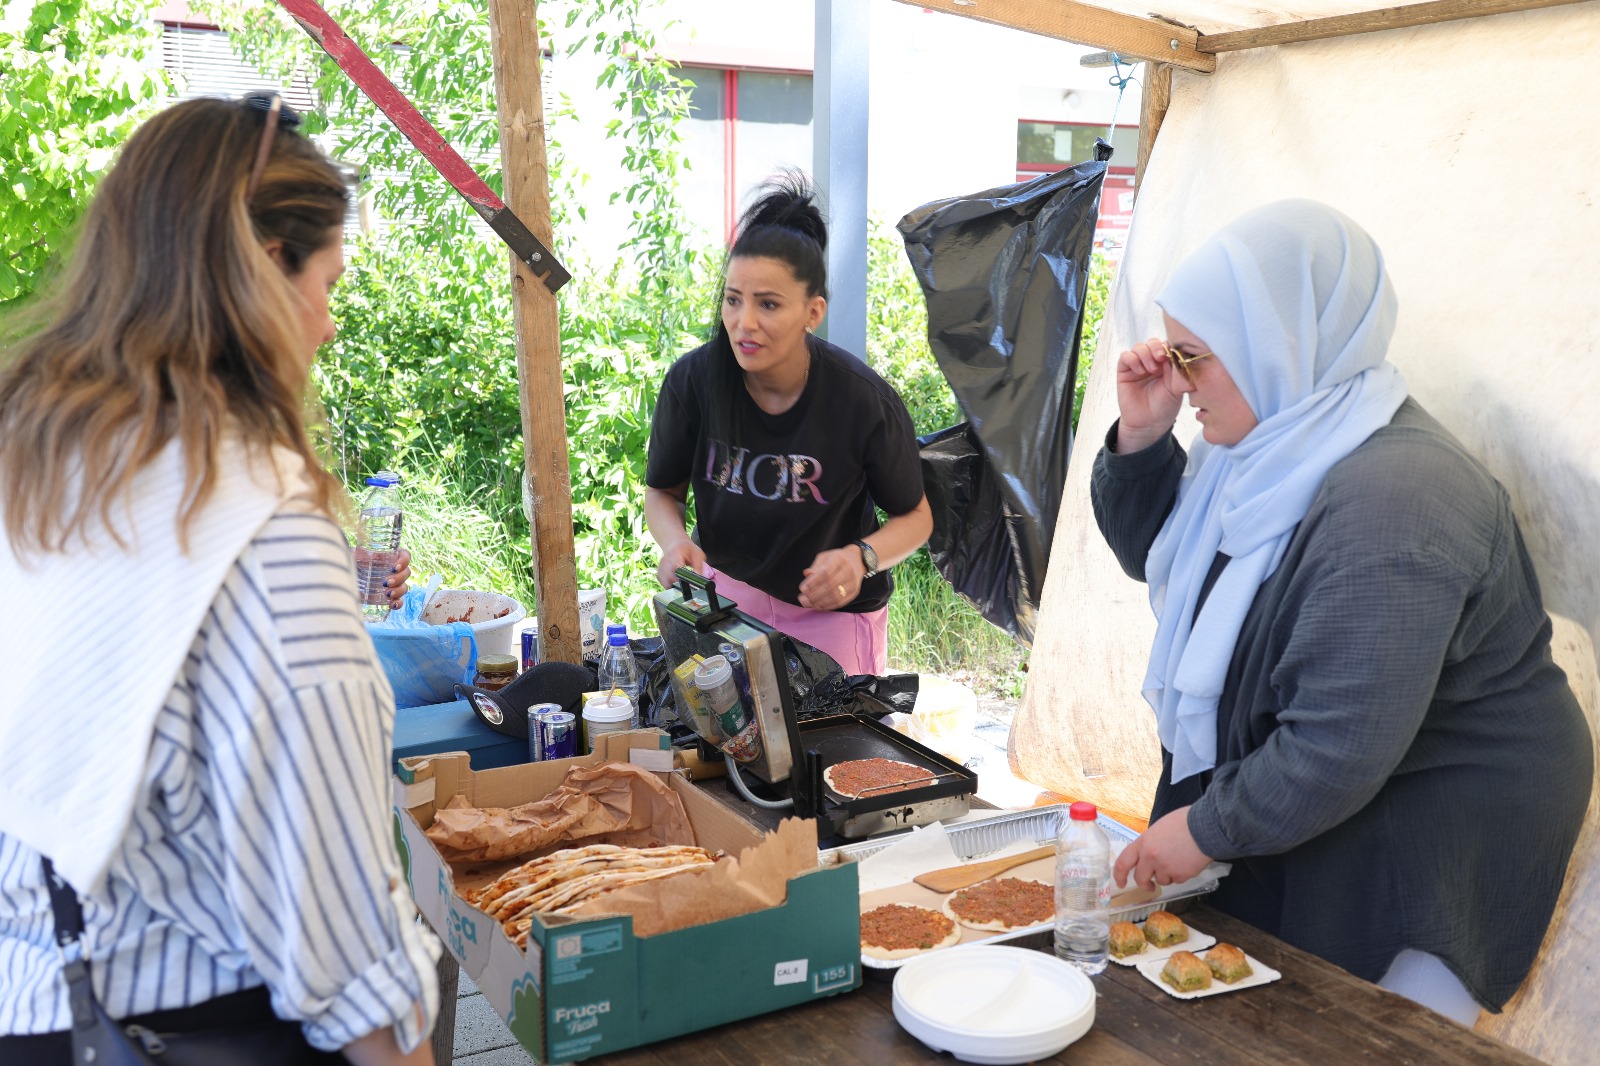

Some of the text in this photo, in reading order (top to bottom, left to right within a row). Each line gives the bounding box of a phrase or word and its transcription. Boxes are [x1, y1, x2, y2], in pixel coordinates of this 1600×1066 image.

[704, 438, 830, 505] DIOR
[823, 967, 847, 982] 155
[555, 1001, 611, 1023] Fruca
